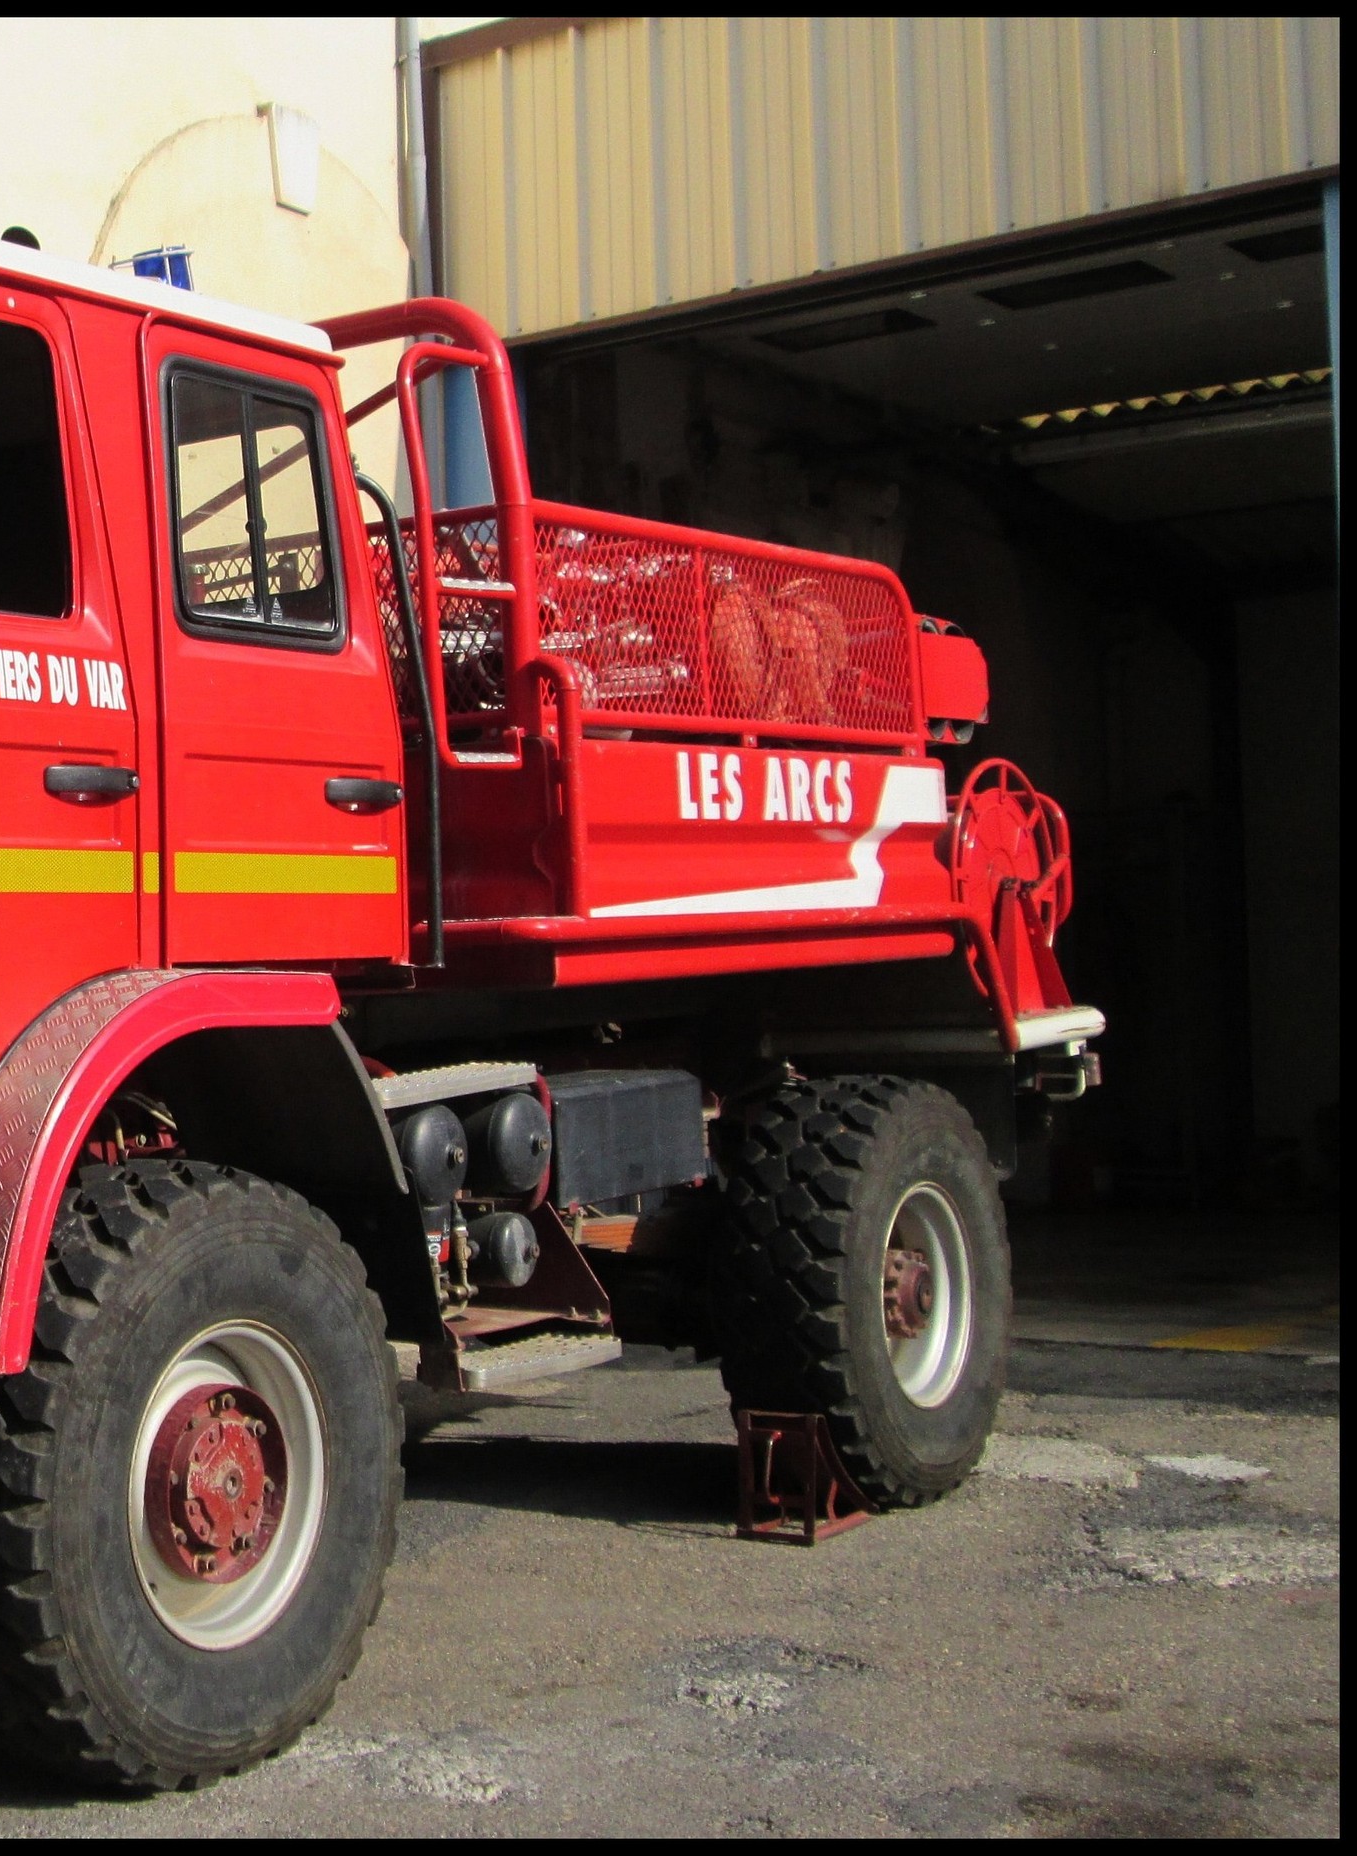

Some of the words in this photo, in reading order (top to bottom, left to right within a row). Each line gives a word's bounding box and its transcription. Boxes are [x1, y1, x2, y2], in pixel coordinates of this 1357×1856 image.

[46, 655, 78, 706] DU
[83, 659, 127, 711] VAR
[676, 751, 744, 821] LES
[762, 757, 854, 823] ARCS
